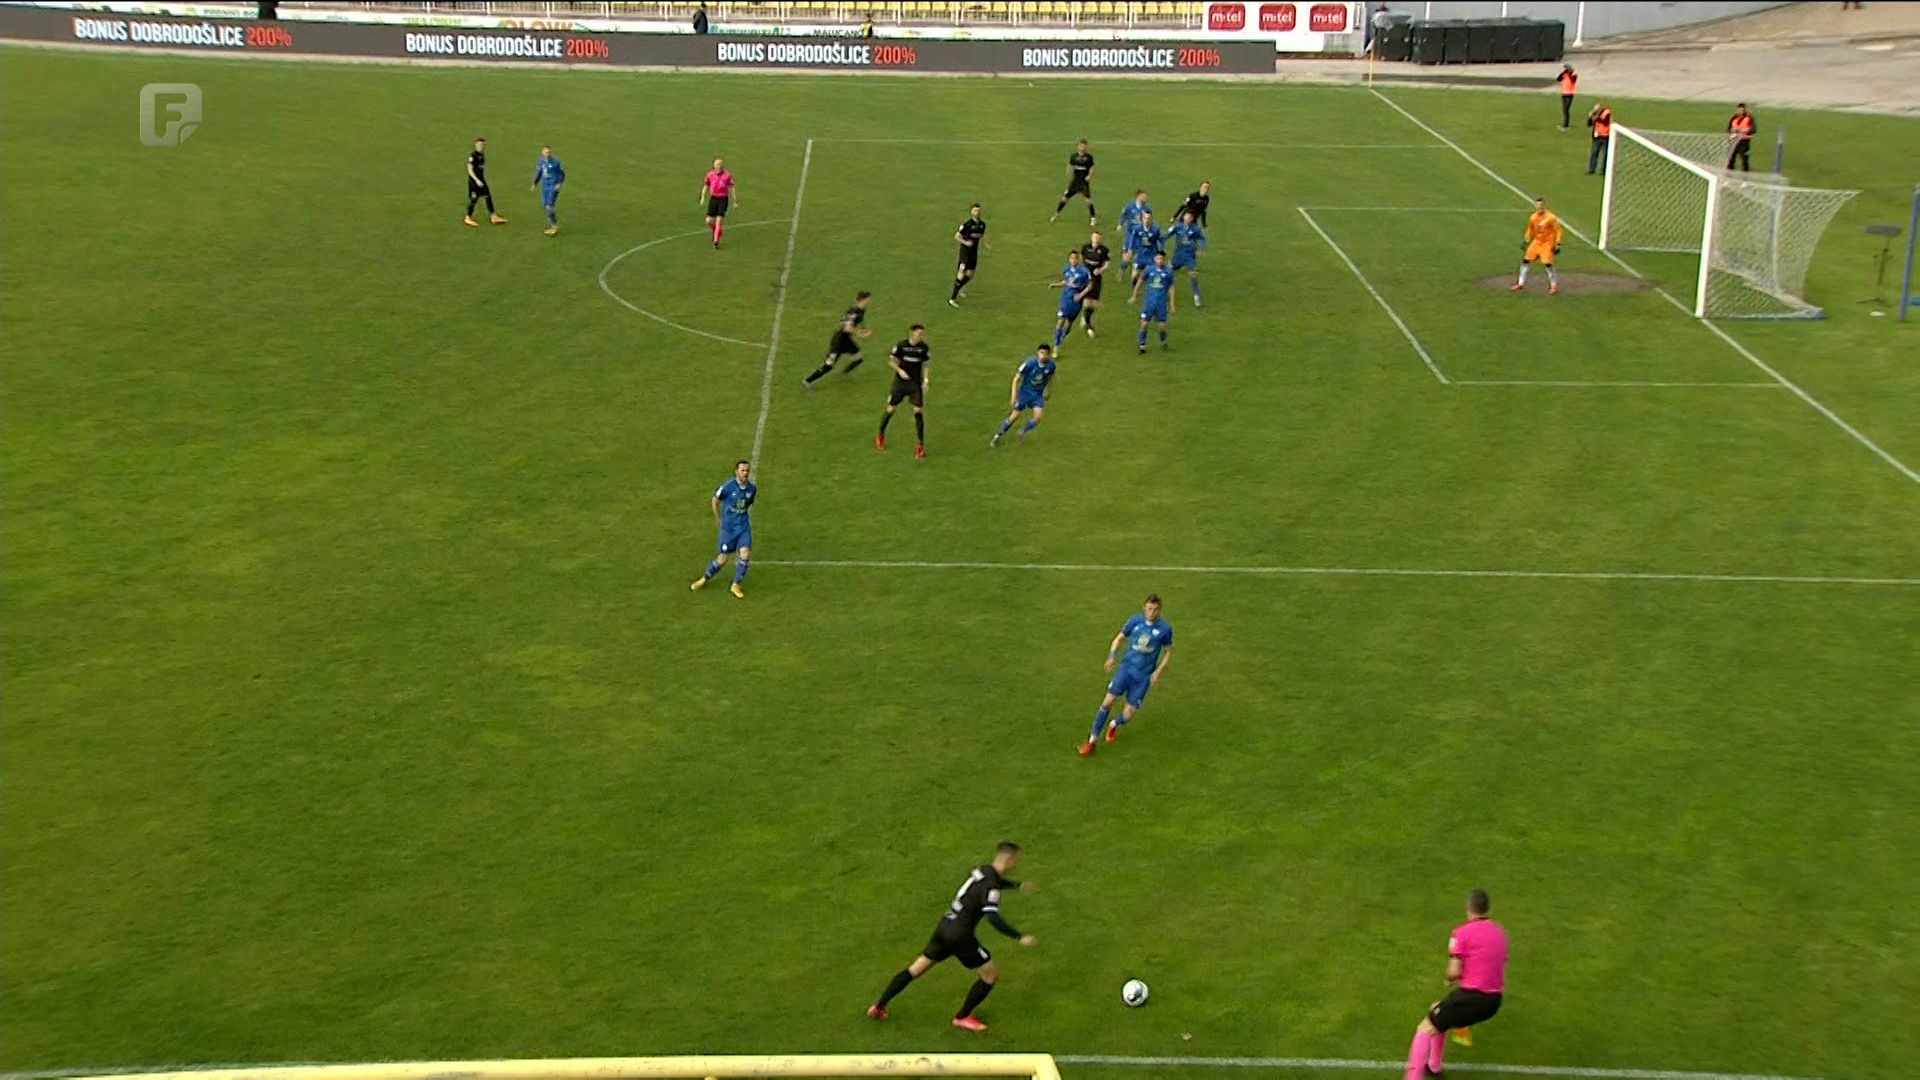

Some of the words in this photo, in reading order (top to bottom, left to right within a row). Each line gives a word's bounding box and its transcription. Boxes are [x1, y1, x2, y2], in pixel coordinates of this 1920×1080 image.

[74, 17, 127, 39] BONUS
[129, 21, 244, 46] DOBRODOŠLICE
[246, 26, 292, 46] 200%
[405, 33, 454, 54] BONUS
[457, 34, 563, 57] DOBRODOŠLICE
[566, 39, 609, 58] 200%
[717, 43, 764, 62] BONUS
[767, 42, 871, 64] DOBRODOŠLICE
[874, 46, 916, 64] 200%
[1023, 49, 1069, 67] BONUS
[1072, 46, 1175, 68] DOBRODOŠLICE
[1178, 49, 1220, 67] 200%
